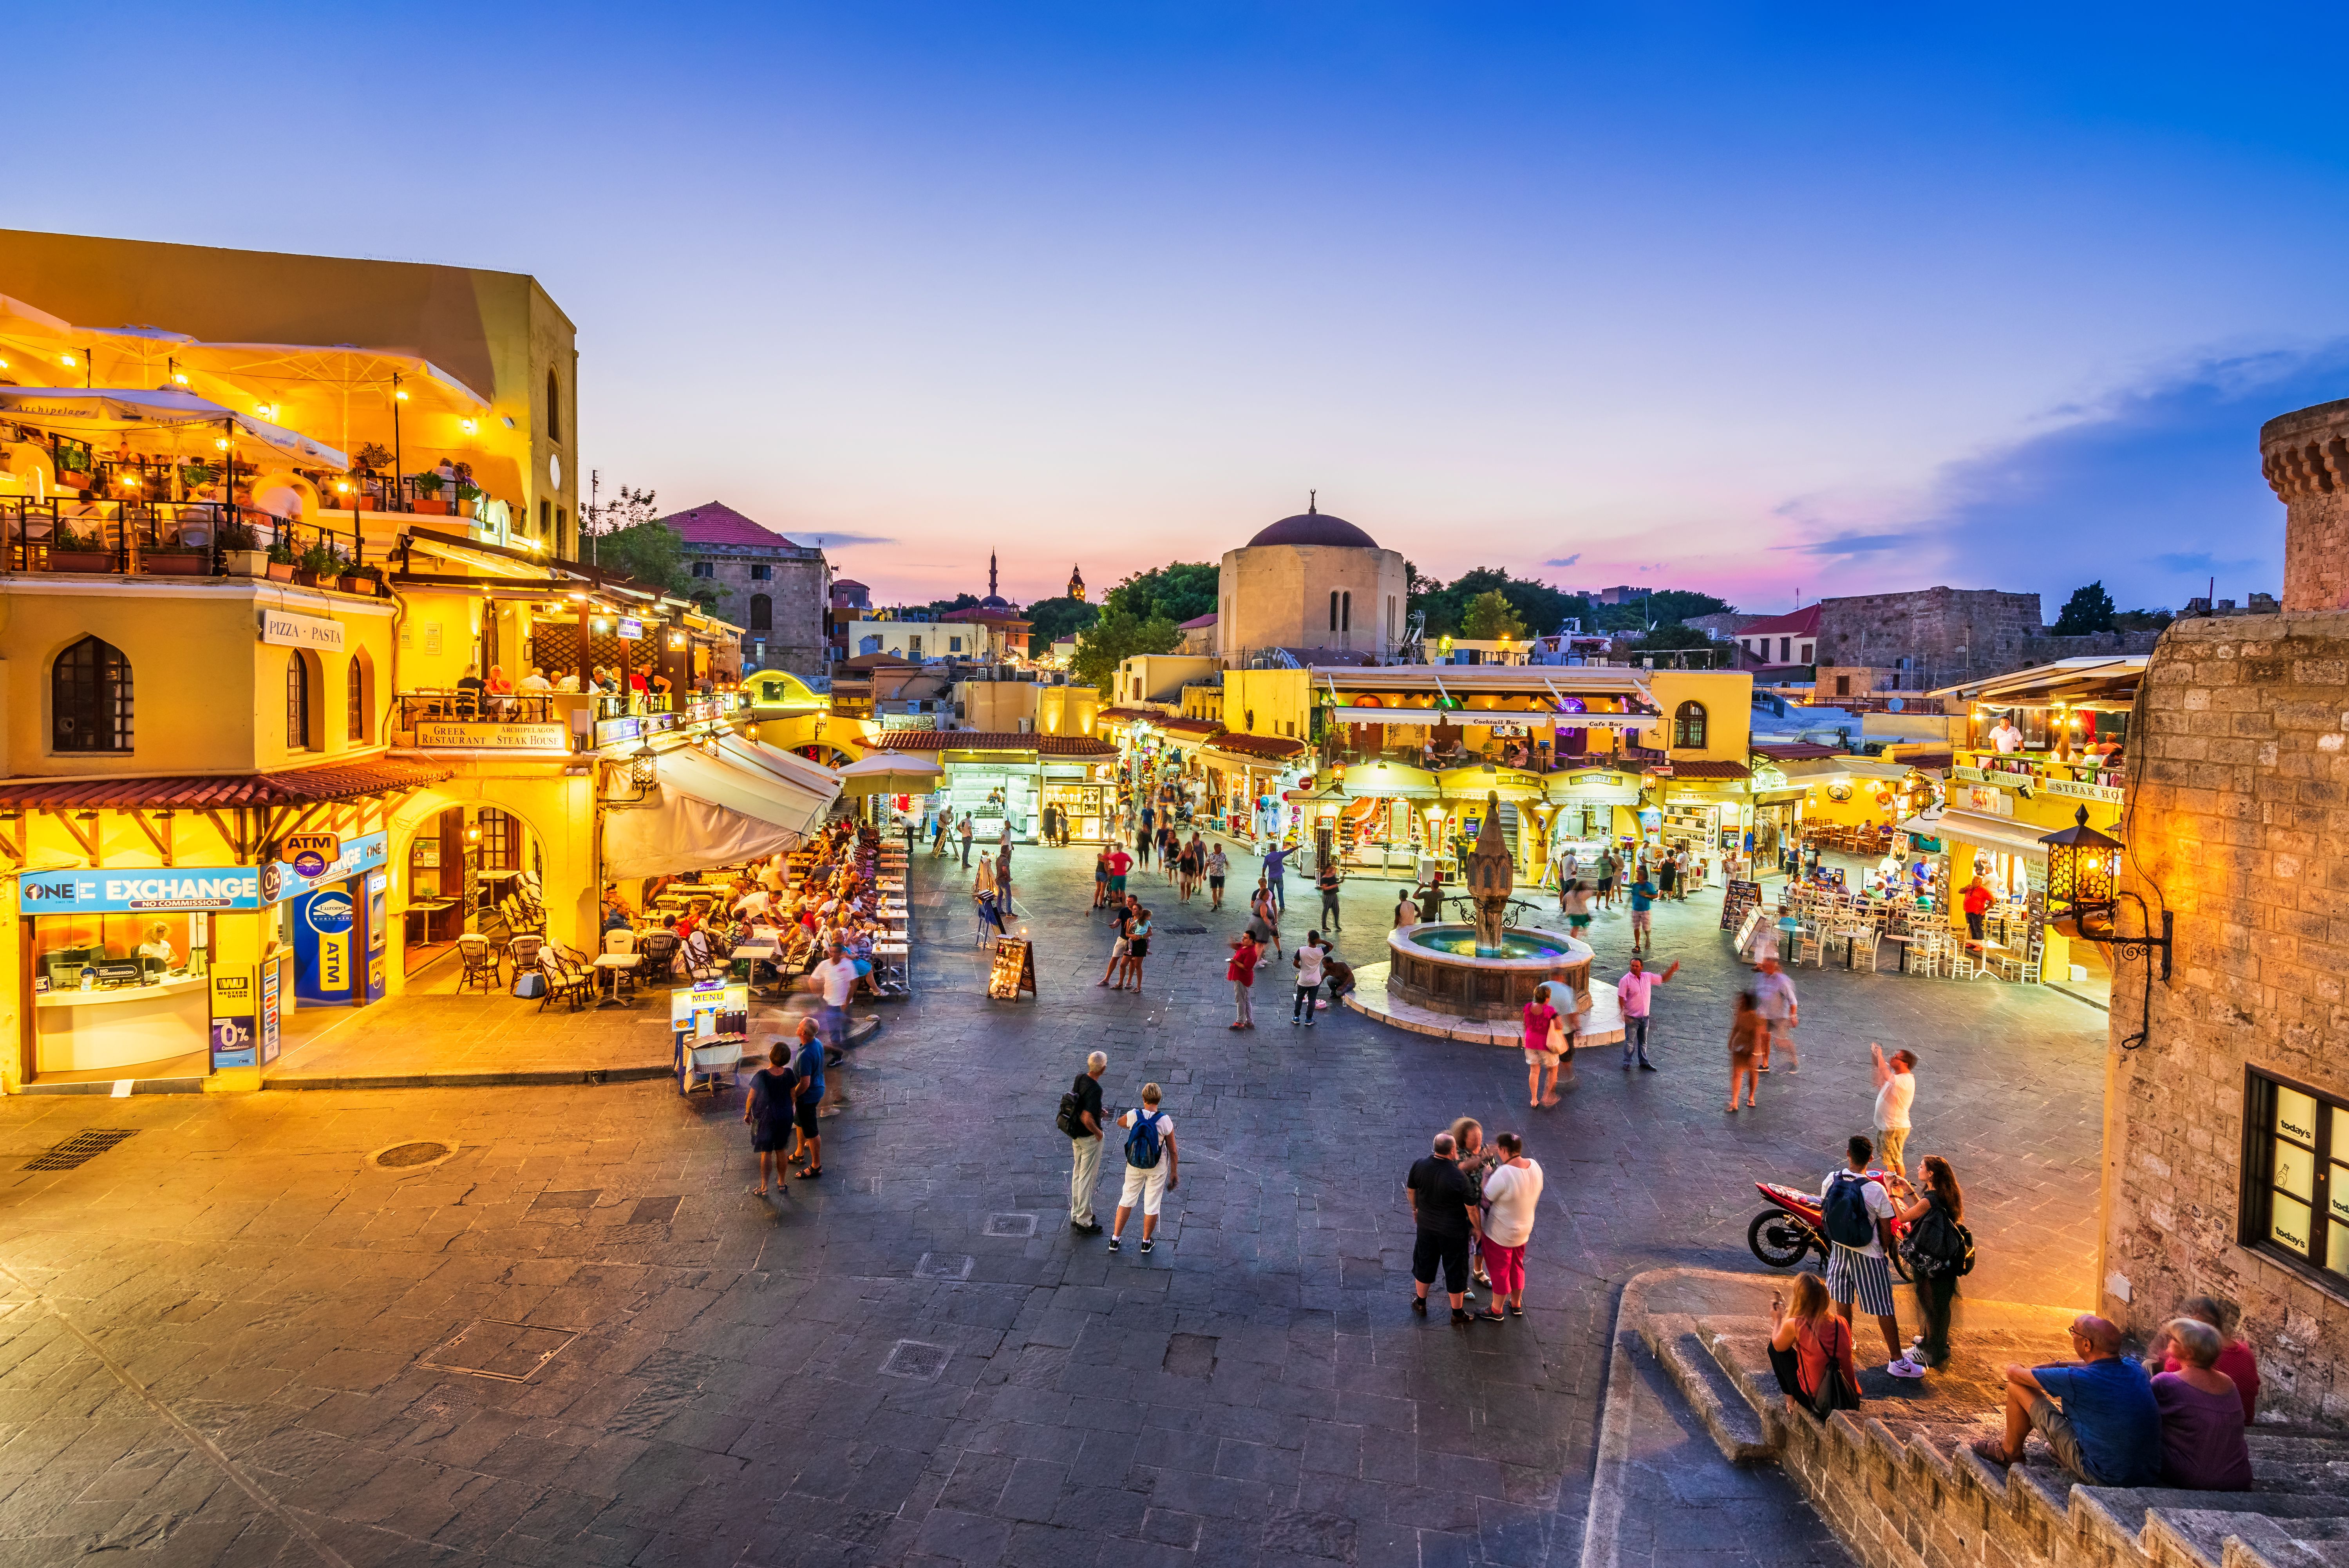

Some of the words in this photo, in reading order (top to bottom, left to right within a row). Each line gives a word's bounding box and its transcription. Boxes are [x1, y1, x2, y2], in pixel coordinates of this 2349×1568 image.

[269, 621, 299, 637] PIZZA
[312, 627, 341, 643] PASTA
[434, 726, 466, 735] GREEK
[598, 728, 609, 741] Steak
[610, 725, 622, 738] House
[422, 734, 486, 744] RESTAURANT
[497, 736, 527, 745] STEAK
[530, 736, 559, 745] HOUSE
[1582, 775, 1611, 783] NEFELI
[1961, 769, 1981, 779] GREEK
[1985, 772, 2024, 785] STAURANT
[2056, 783, 2096, 796] STEAK
[2101, 789, 2120, 800] HO
[287, 837, 331, 849] ATM
[366, 842, 381, 859] ONE
[265, 871, 280, 890] 0%
[321, 870, 348, 884] COMMISSION
[373, 879, 385, 890] ATM
[25, 883, 74, 900] ONE
[106, 877, 257, 900] EXCHANGE
[327, 942, 339, 983] ATM
[371, 959, 383, 971] ATM
[222, 978, 244, 989] WU
[693, 993, 723, 1002] MENU
[221, 1024, 249, 1046] 0%
[2280, 1119, 2311, 1139] today's
[2275, 1226, 2305, 1248] today's
